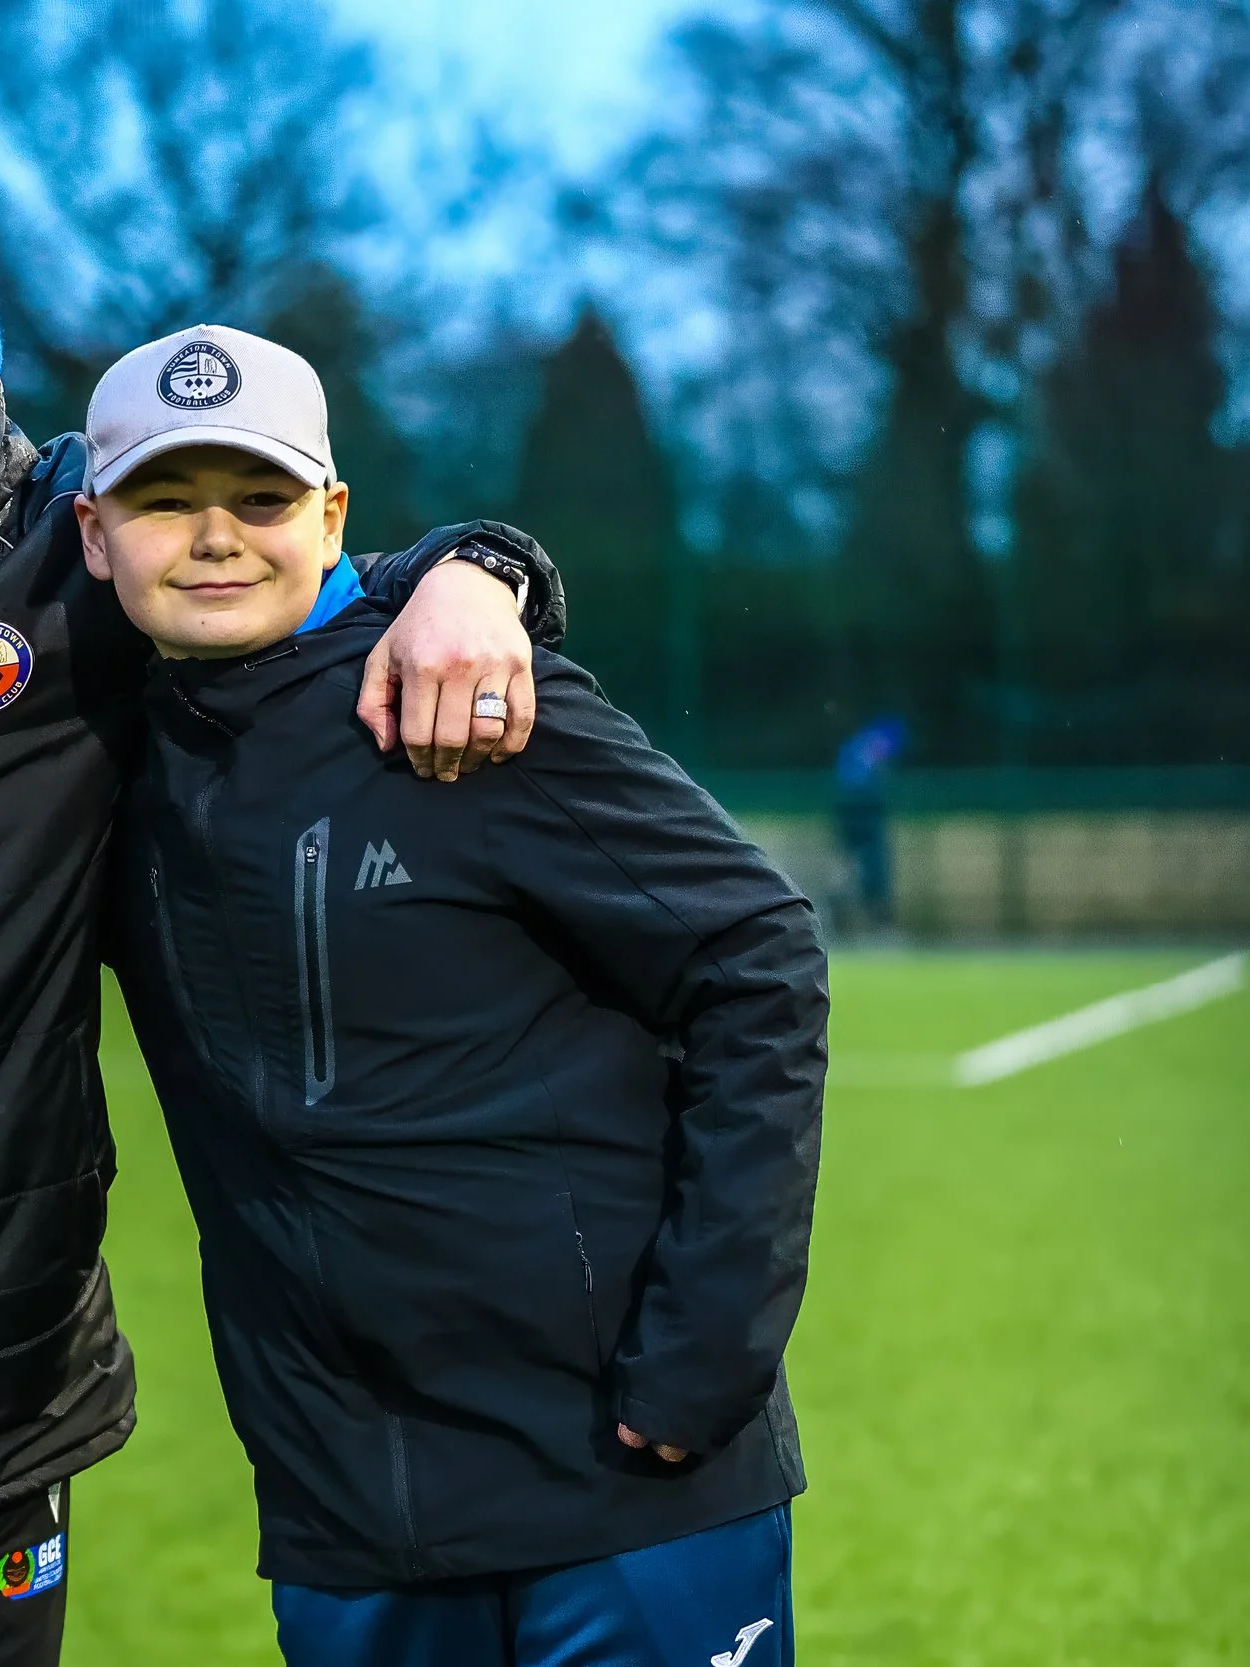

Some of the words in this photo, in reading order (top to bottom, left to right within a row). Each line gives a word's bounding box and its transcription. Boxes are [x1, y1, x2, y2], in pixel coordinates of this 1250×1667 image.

[166, 345, 207, 373] NUNEATON
[211, 348, 232, 369] TOWN
[166, 392, 209, 406] FOOTBALL
[212, 389, 231, 403] CLUB
[1, 681, 23, 703] CLUB
[38, 1534, 62, 1567] GCE
